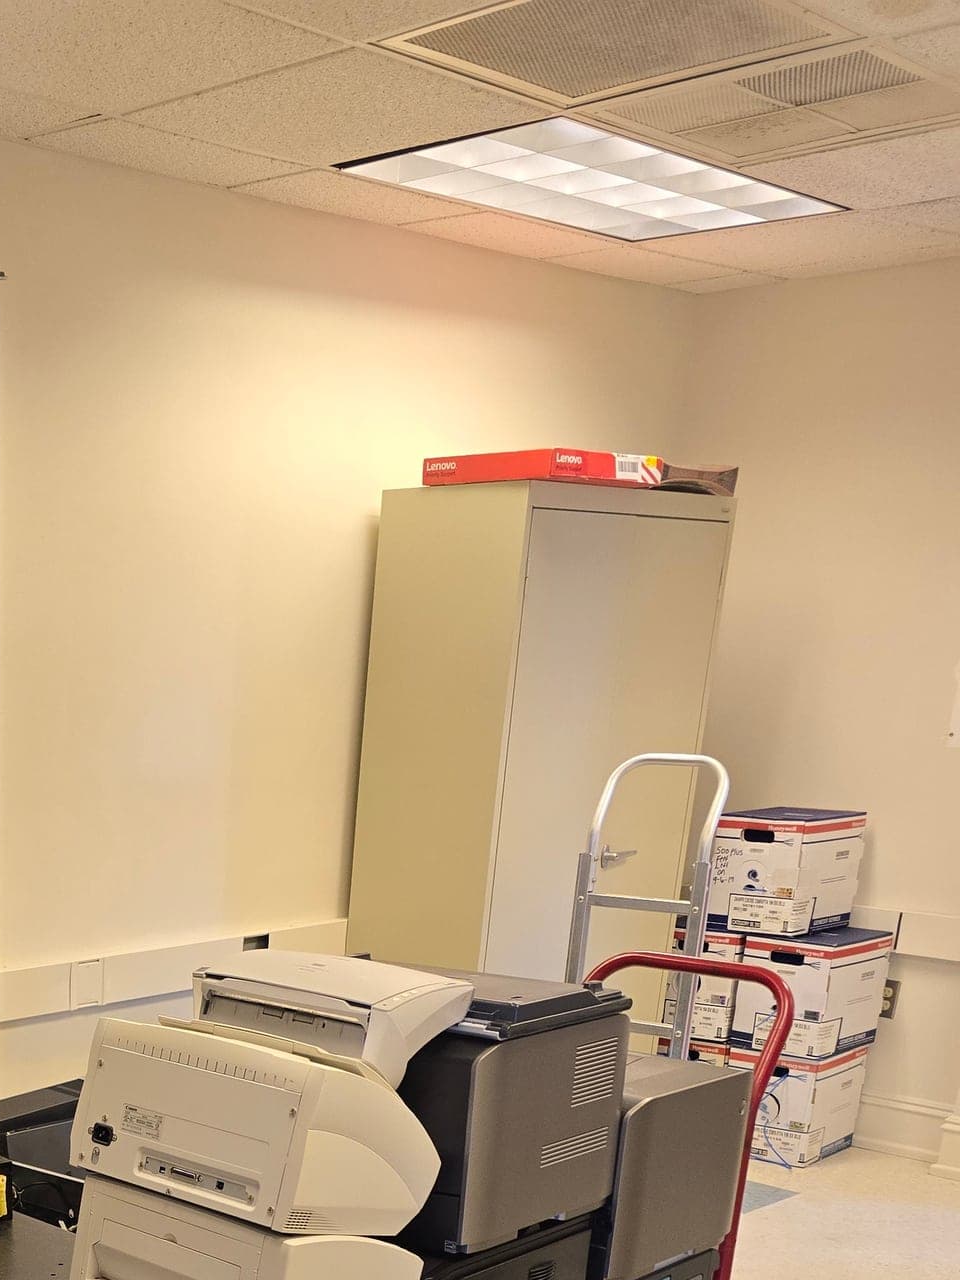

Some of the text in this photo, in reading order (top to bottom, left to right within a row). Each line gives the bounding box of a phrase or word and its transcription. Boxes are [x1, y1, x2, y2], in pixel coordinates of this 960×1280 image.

[555, 452, 583, 464] Lenovo
[426, 461, 456, 471] Lenovo
[768, 824, 797, 833] Honeywell
